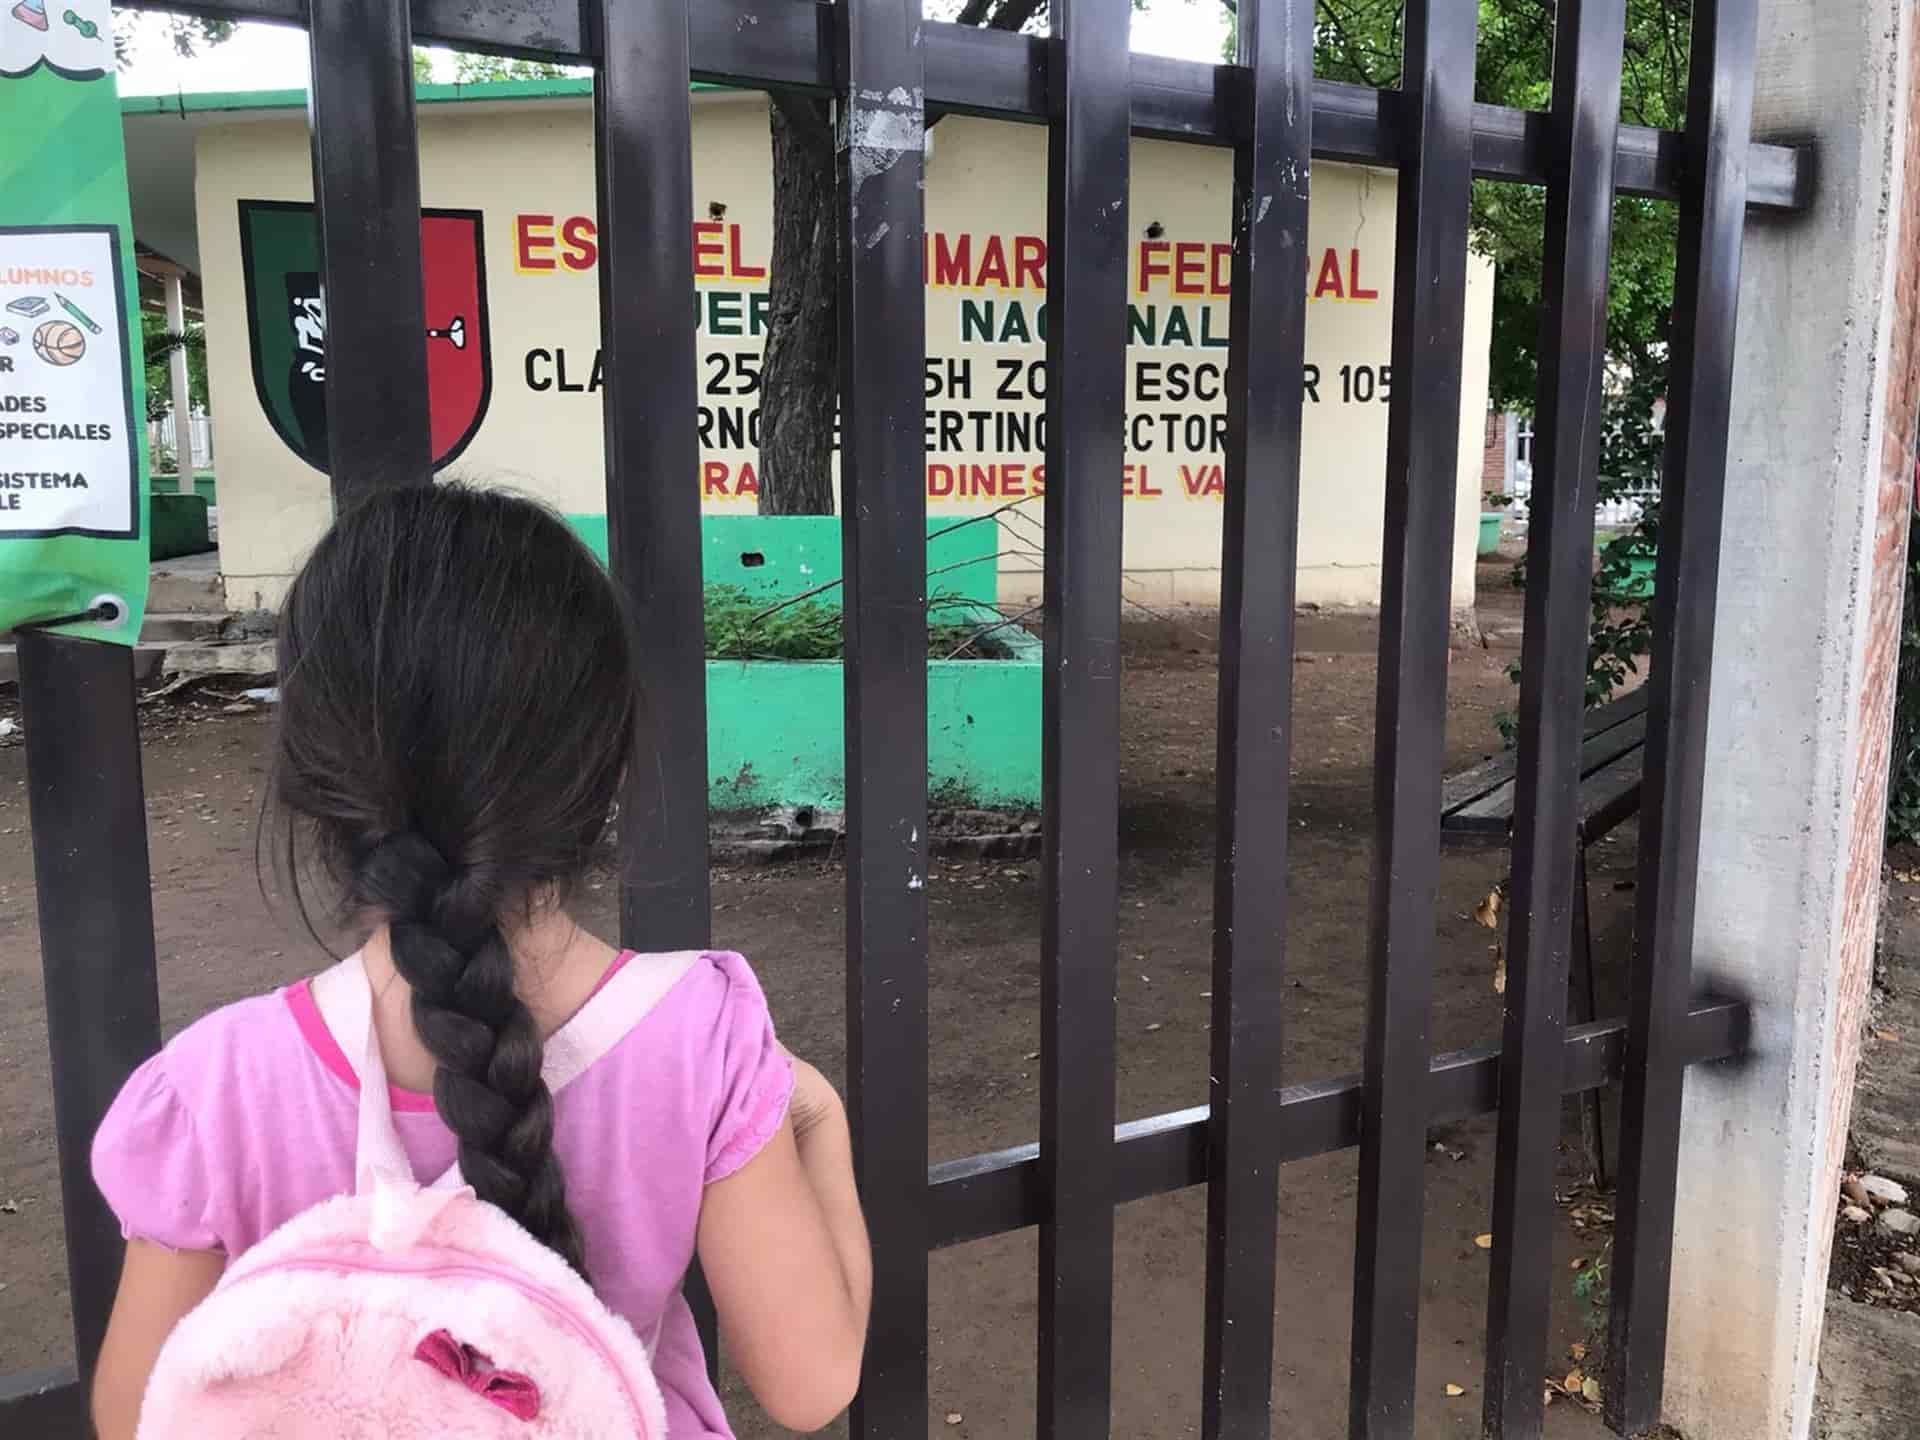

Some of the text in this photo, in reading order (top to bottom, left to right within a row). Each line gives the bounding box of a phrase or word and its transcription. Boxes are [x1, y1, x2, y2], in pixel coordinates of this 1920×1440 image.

[0, 267, 94, 287] LUMNOS
[513, 215, 1379, 303] ESEL IMAR FEDAL
[961, 300, 1230, 347] NANAL
[524, 348, 607, 393] CLA
[995, 359, 1048, 400] ZO
[1135, 361, 1321, 402] ESCR
[0, 422, 111, 442] PECIALES
[0, 472, 89, 490] ISTEMA
[928, 463, 1047, 502] DINES
[1123, 465, 1163, 500] EL
